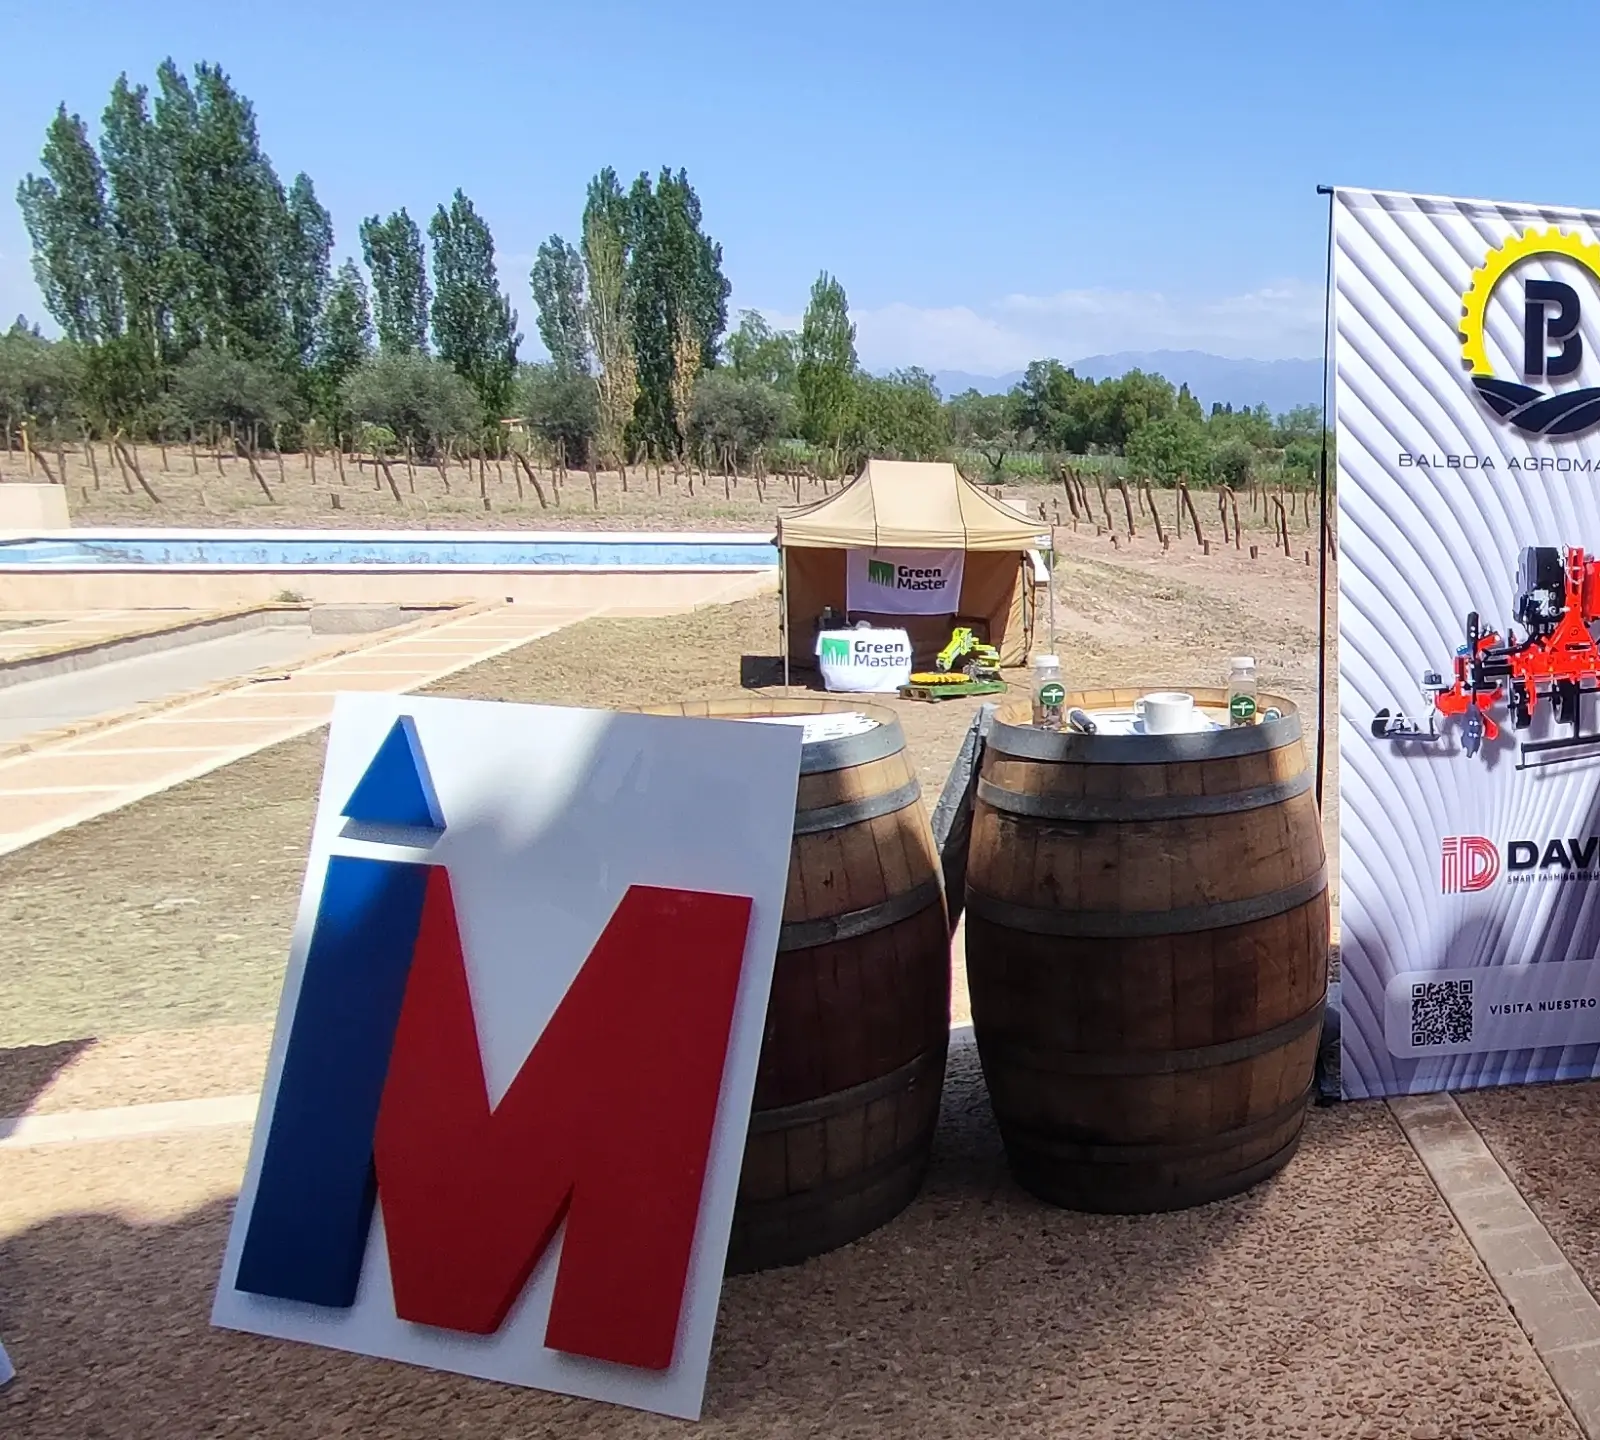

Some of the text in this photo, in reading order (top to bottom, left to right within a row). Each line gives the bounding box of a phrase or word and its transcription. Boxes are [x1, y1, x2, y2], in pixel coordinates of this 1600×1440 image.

[1523, 279, 1583, 378] B
[1398, 453, 1496, 470] BALBOA
[897, 565, 942, 579] Green
[897, 578, 948, 591] Master
[854, 640, 904, 653] Green
[854, 654, 909, 668] Master
[1507, 873, 1536, 885] SMART
[1489, 1003, 1533, 1016] VISITA
[1538, 998, 1597, 1012] NUESTRO
